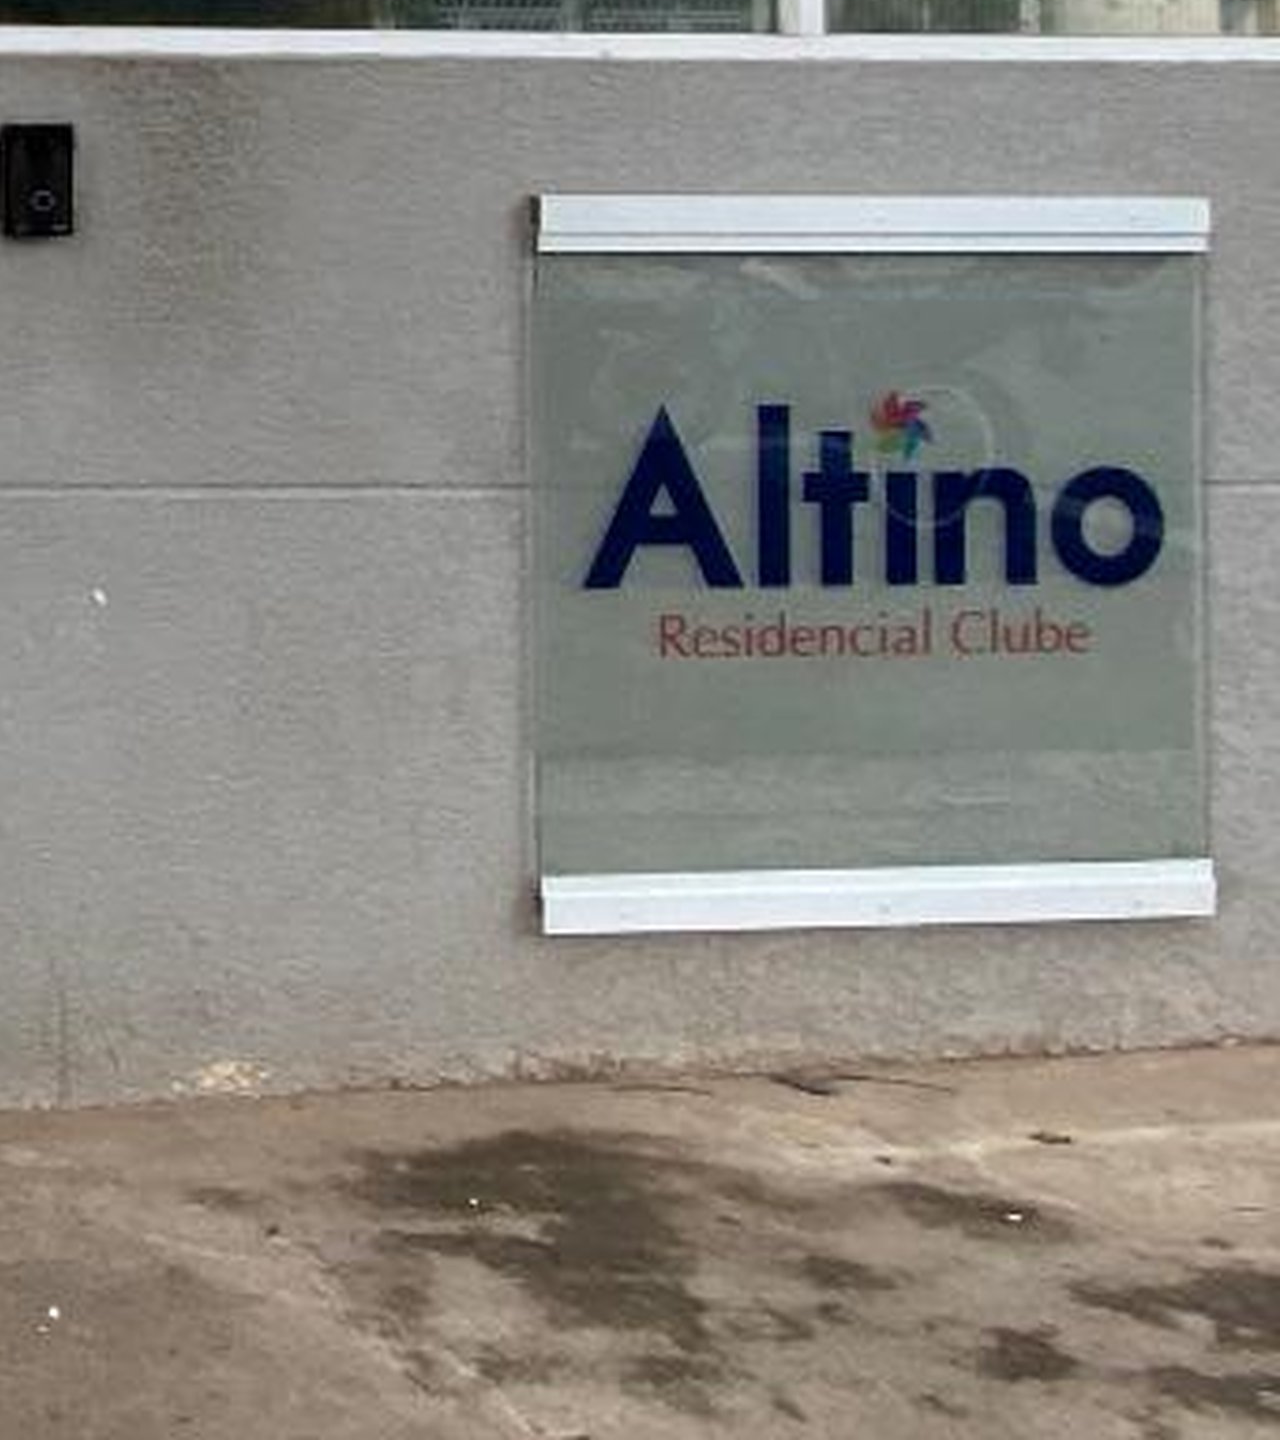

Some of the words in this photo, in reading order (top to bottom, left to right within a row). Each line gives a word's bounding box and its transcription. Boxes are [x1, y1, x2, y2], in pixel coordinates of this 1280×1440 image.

[583, 403, 1165, 588] Altino
[658, 609, 934, 659] Residencial
[950, 606, 1093, 656] Clube
